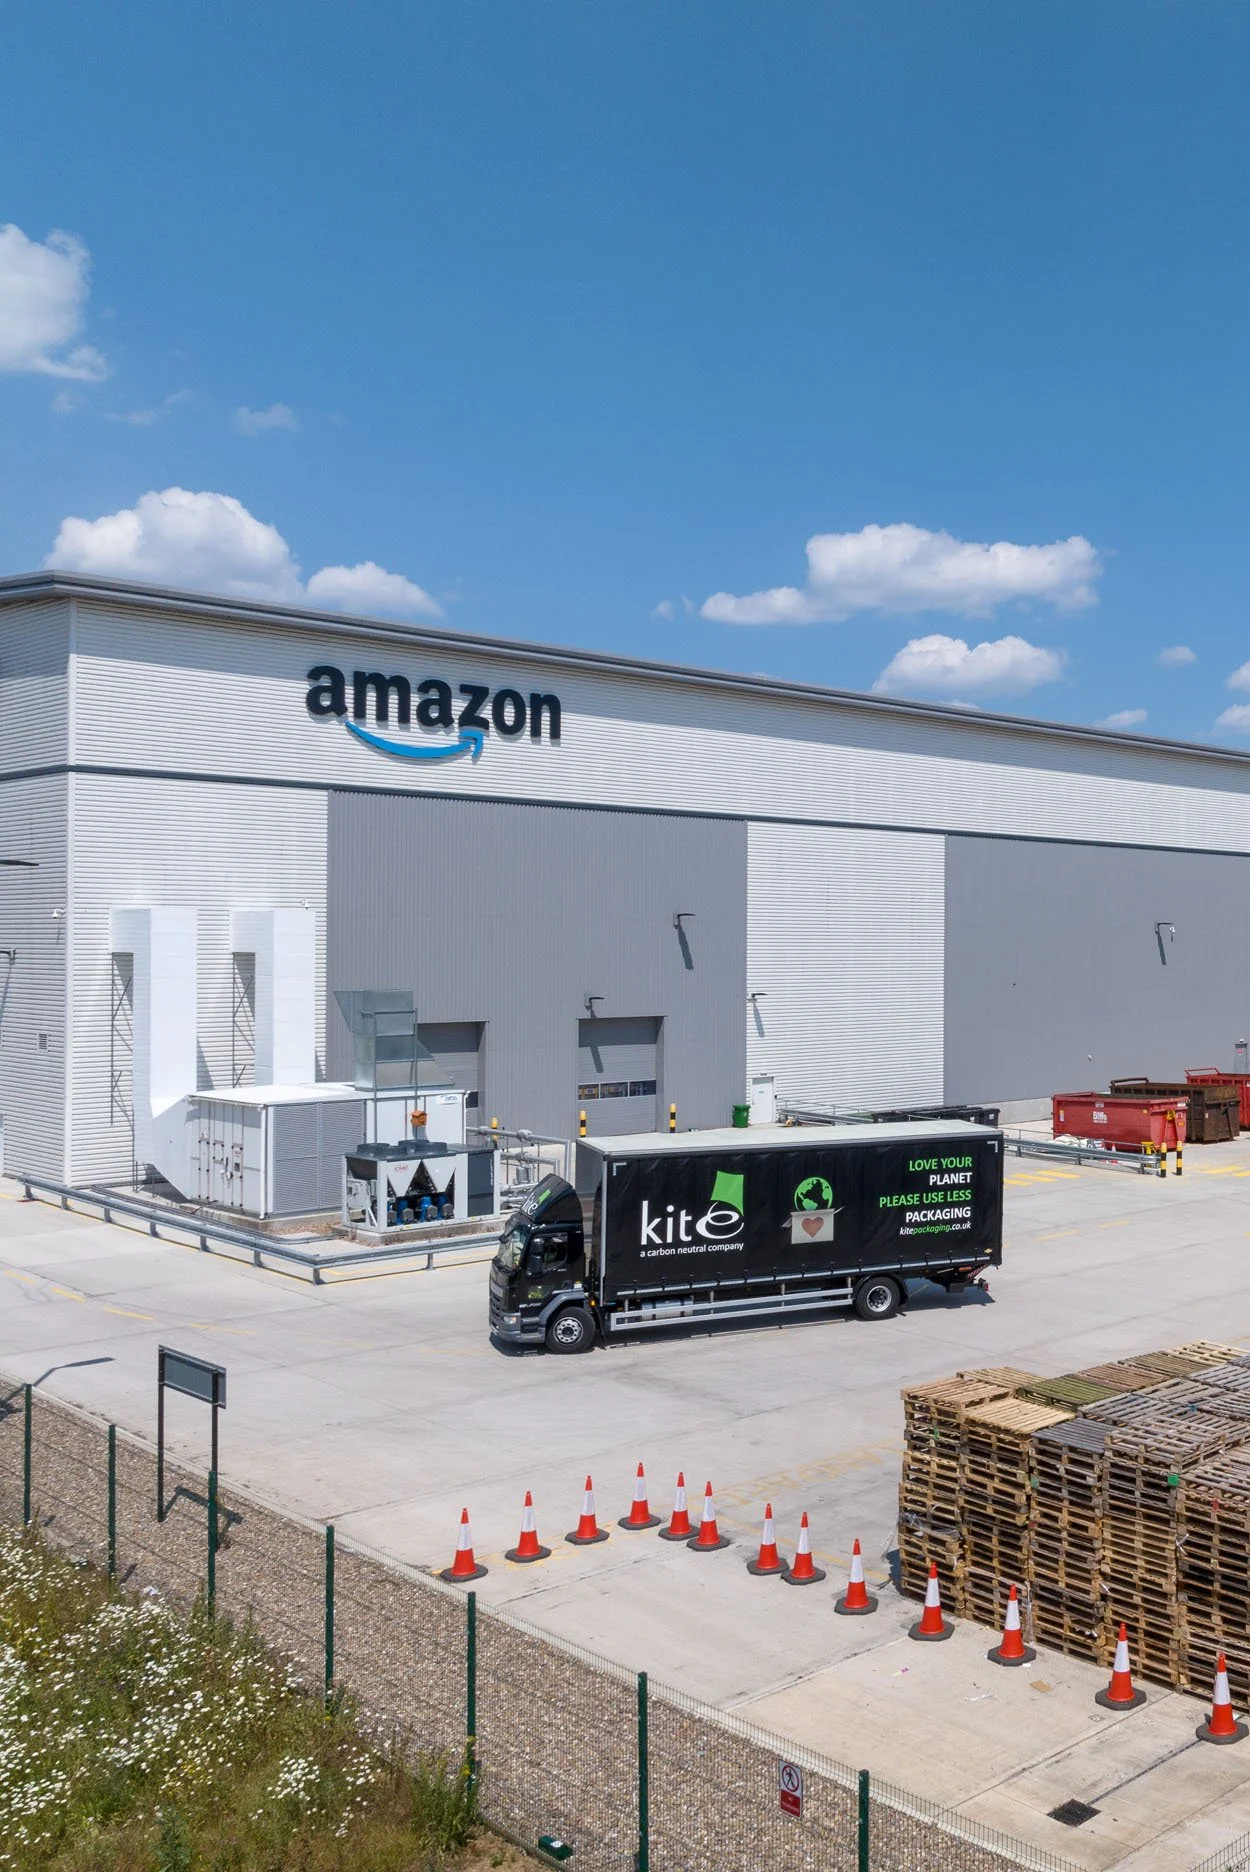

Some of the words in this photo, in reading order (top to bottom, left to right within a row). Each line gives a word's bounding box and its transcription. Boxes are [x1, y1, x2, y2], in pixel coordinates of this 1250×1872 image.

[306, 665, 562, 739] amazon
[909, 1158, 938, 1172] LOVE
[941, 1156, 973, 1169] YOUR
[929, 1172, 973, 1186] PLANET
[879, 1193, 920, 1208] PLEASE
[923, 1191, 945, 1204] USE
[947, 1189, 972, 1202] LESS
[905, 1206, 971, 1223] PACKAGING
[640, 1200, 745, 1246] kite
[899, 1221, 972, 1235] kitepackaging.co.uk
[639, 1250, 646, 1258] a
[647, 1247, 676, 1258] carbon
[677, 1244, 707, 1255] neutral
[707, 1242, 745, 1252] company
